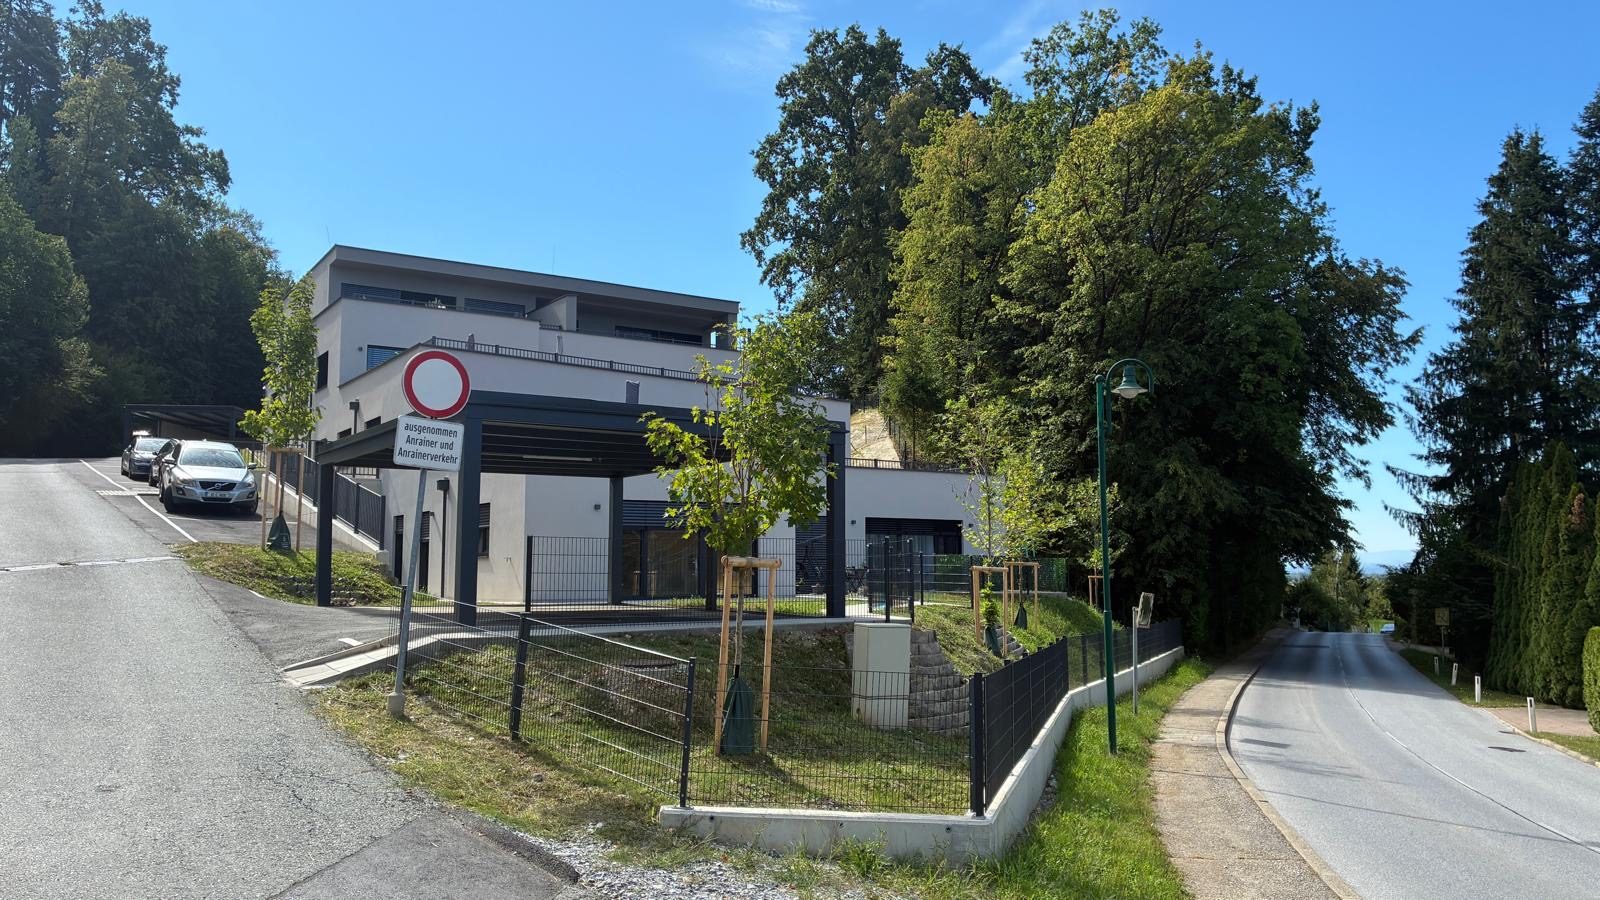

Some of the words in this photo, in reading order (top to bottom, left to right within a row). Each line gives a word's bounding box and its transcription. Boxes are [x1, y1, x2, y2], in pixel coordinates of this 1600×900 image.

[404, 423, 458, 438] ausgenommen
[406, 435, 438, 448] Anrainer
[440, 441, 454, 450] und
[398, 448, 458, 464] Anrainerverkehr
